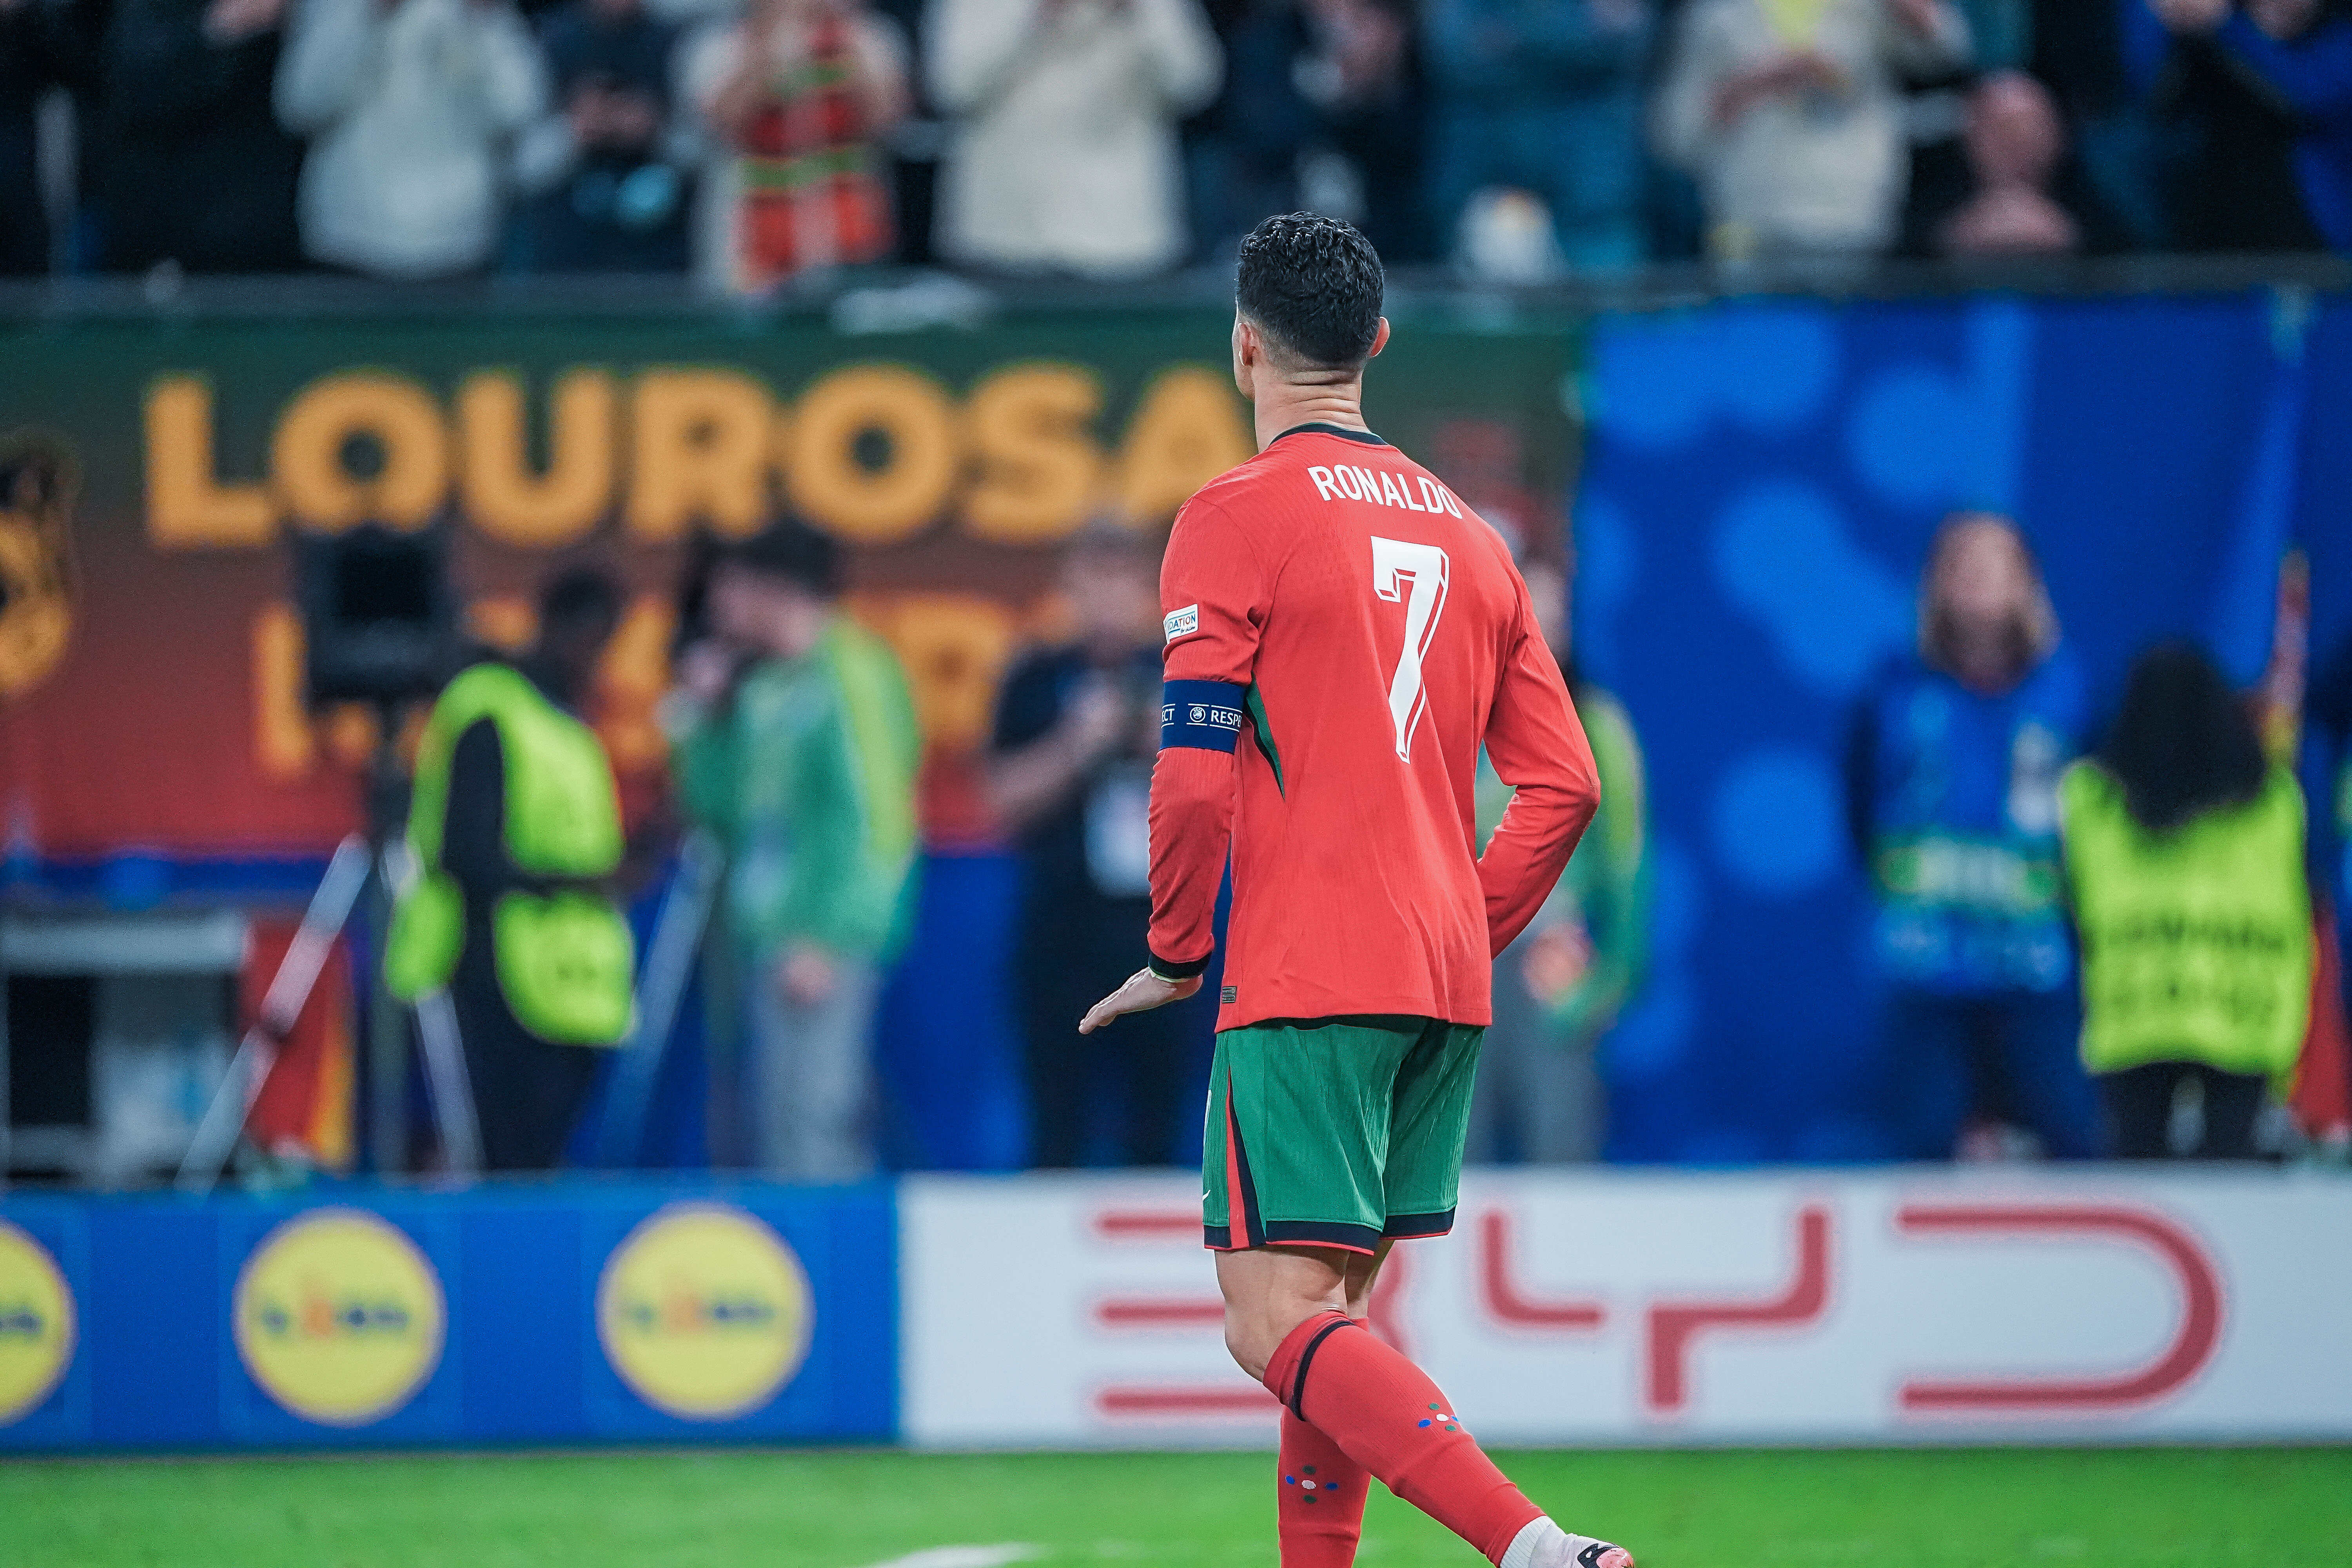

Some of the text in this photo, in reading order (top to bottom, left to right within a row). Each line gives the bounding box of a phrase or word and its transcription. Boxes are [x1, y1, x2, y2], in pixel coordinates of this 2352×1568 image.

[144, 361, 1256, 551] LOUROSA
[1307, 464, 1463, 519] RONALDO
[1370, 535, 1450, 764] 7
[1161, 708, 1175, 722] ECT
[1210, 710, 1242, 728] RESPE
